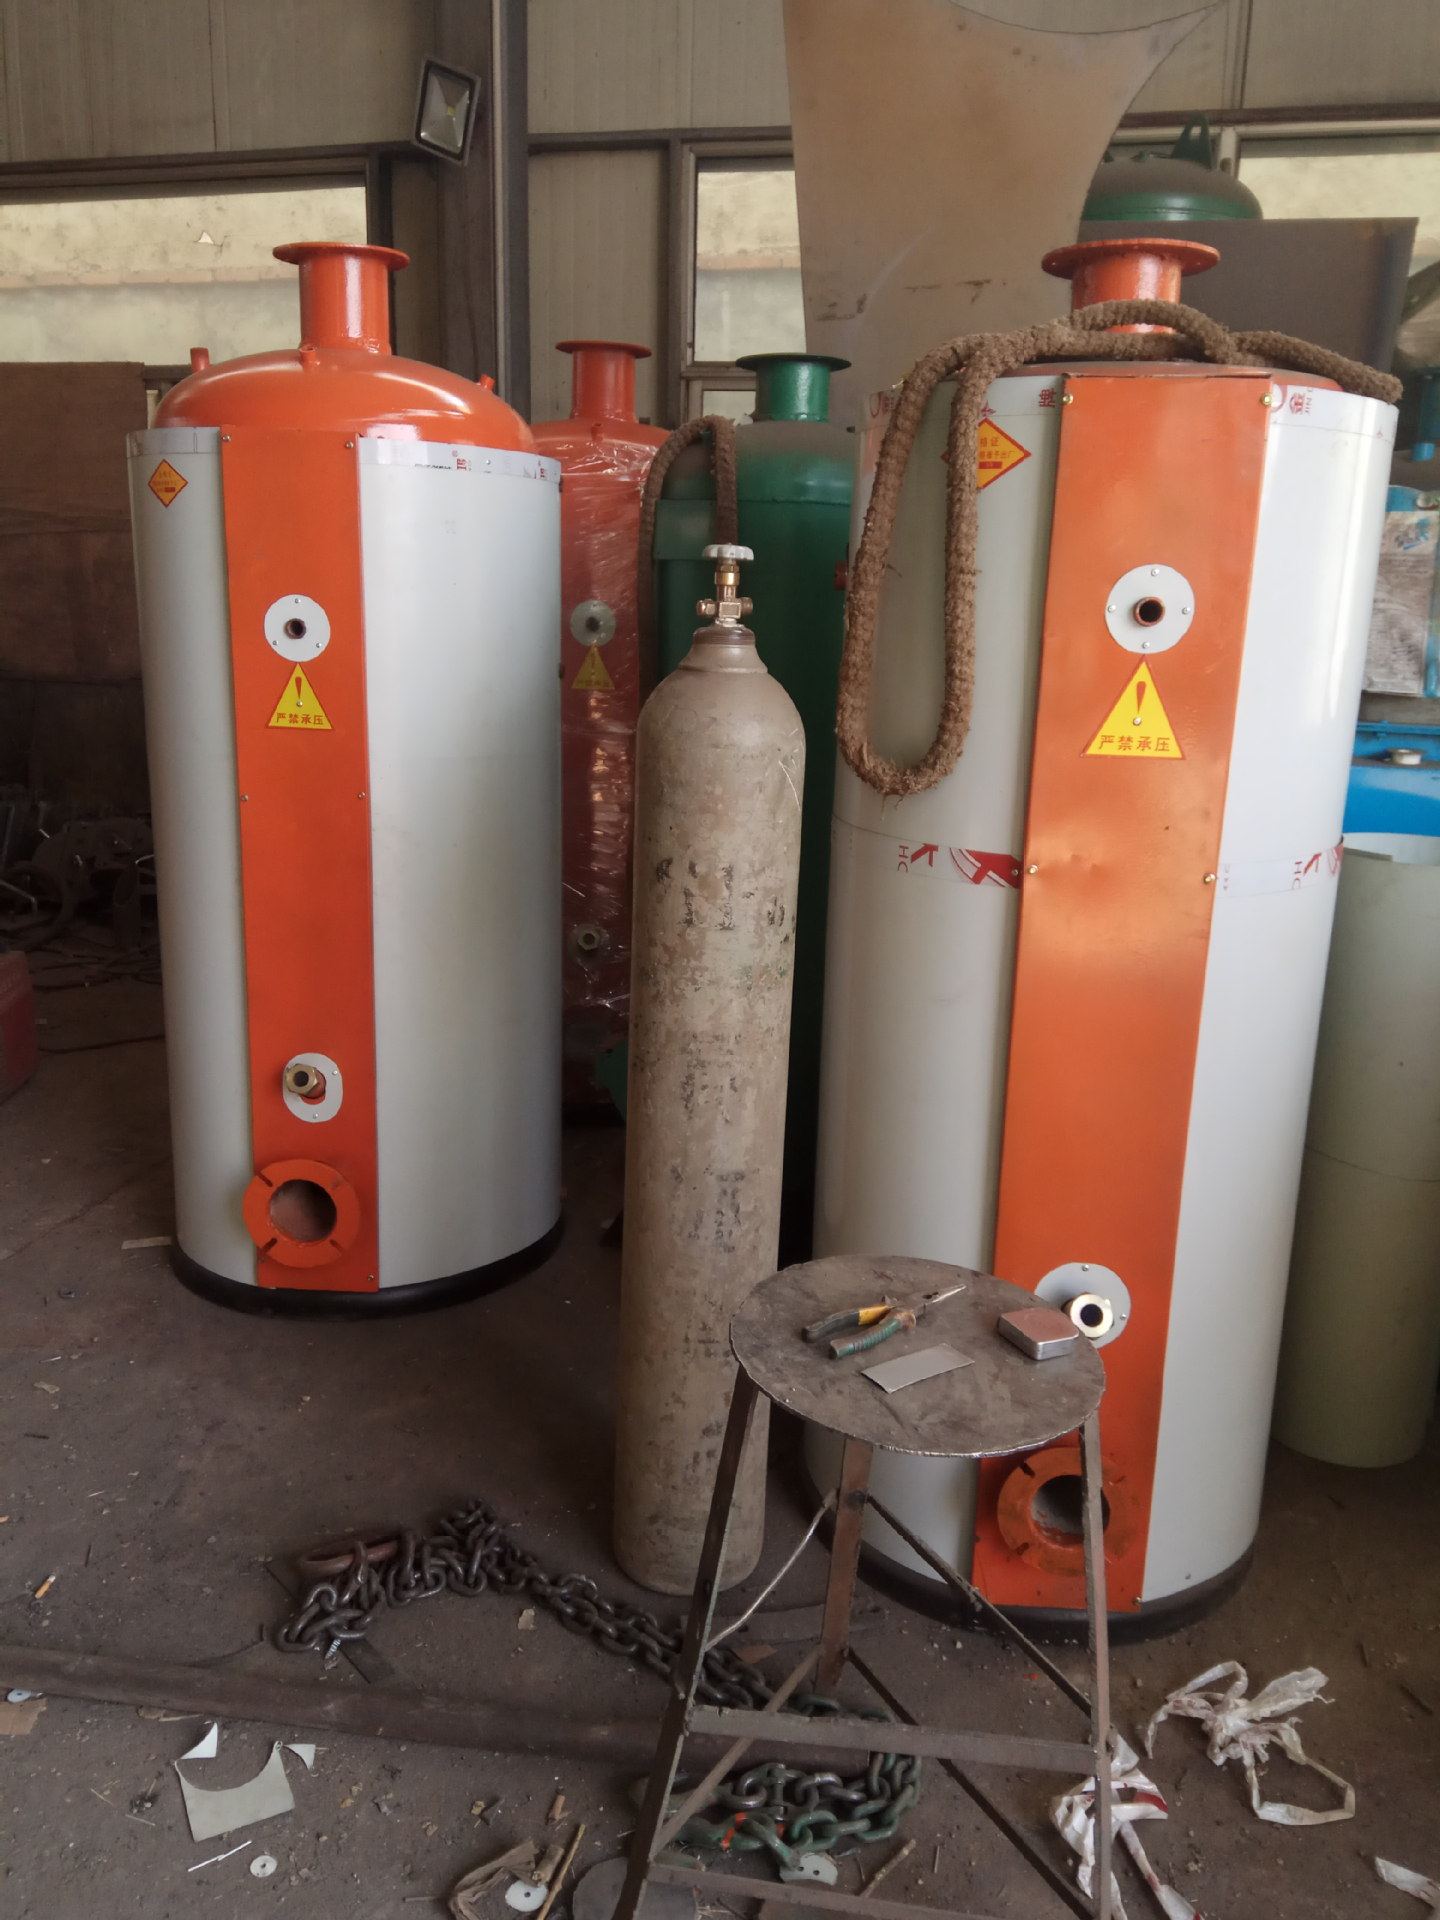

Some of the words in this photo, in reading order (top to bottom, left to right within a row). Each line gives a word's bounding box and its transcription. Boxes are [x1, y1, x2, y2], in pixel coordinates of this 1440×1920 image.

[276, 712, 325, 725] 严禁承压
[1099, 734, 1170, 752] 严禁承压
